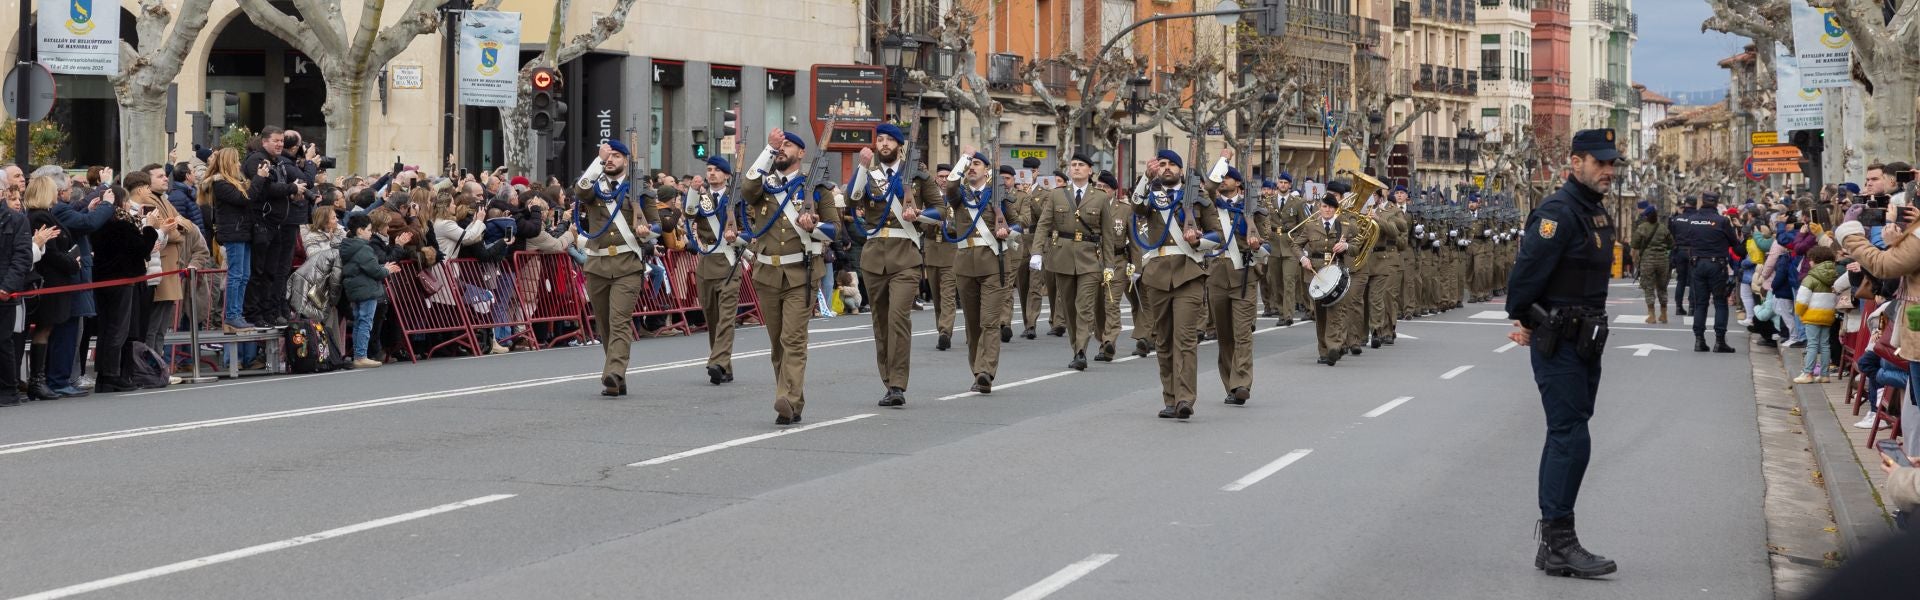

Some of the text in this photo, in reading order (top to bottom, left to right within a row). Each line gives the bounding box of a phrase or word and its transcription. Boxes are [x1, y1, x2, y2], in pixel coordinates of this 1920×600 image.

[208, 62, 215, 73] k
[296, 56, 307, 74] k
[711, 76, 736, 87] kutxabank
